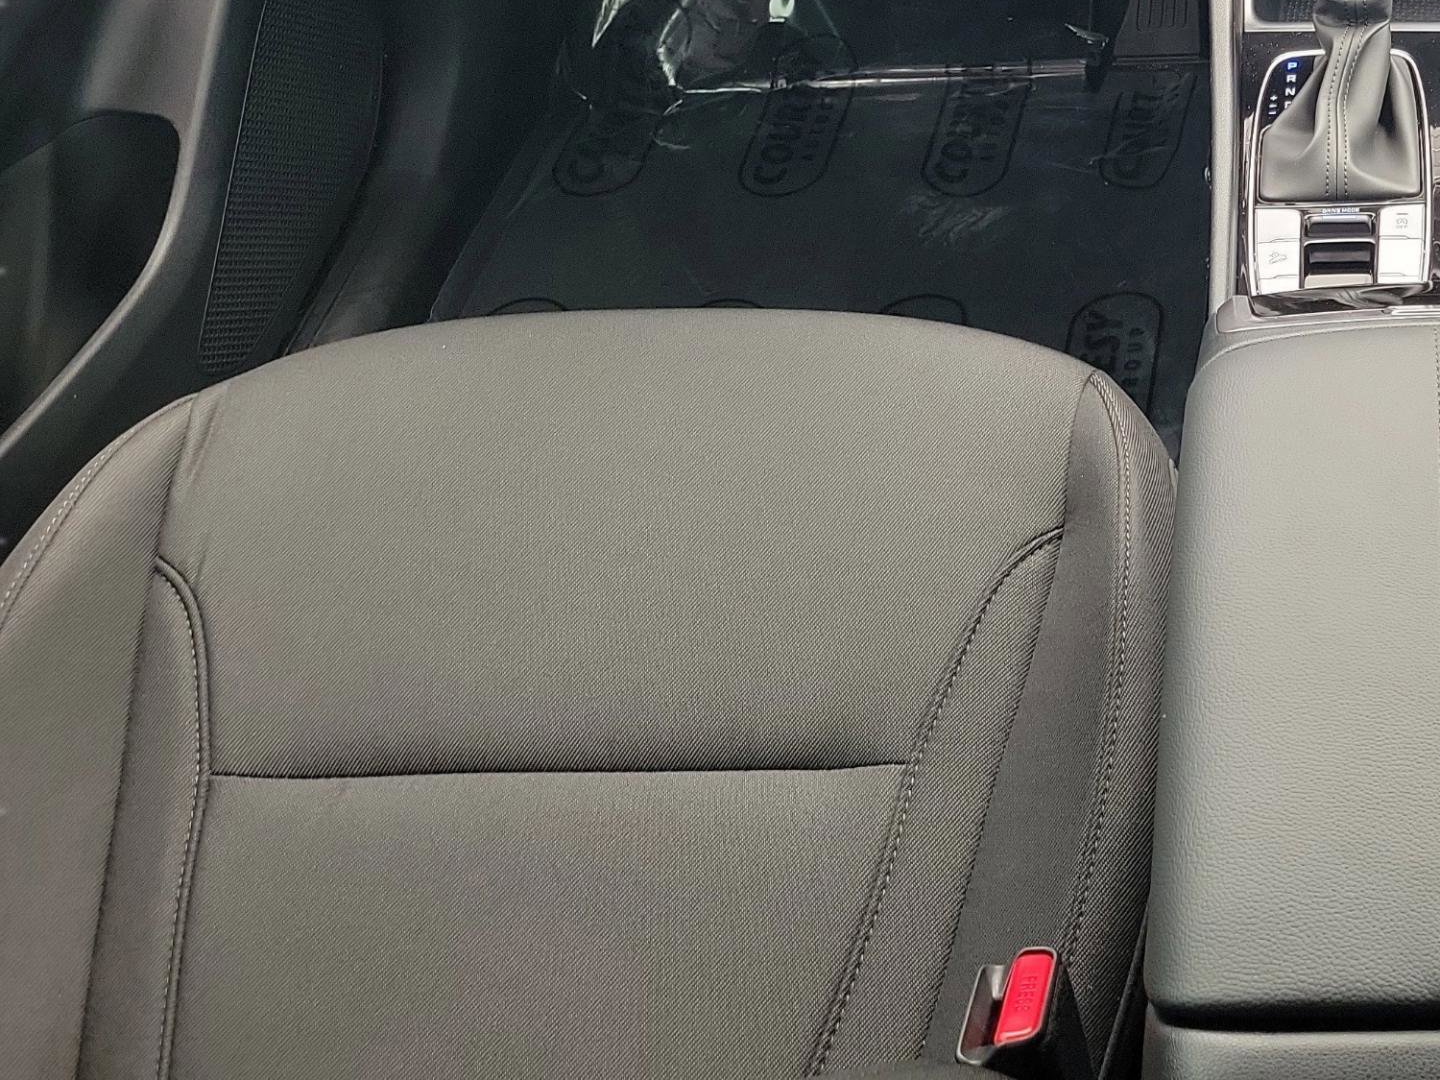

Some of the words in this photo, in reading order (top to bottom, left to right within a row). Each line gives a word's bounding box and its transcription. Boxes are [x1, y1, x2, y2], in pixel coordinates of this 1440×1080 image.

[1287, 61, 1298, 70] P
[1286, 74, 1297, 83] R
[1285, 87, 1296, 96] N
